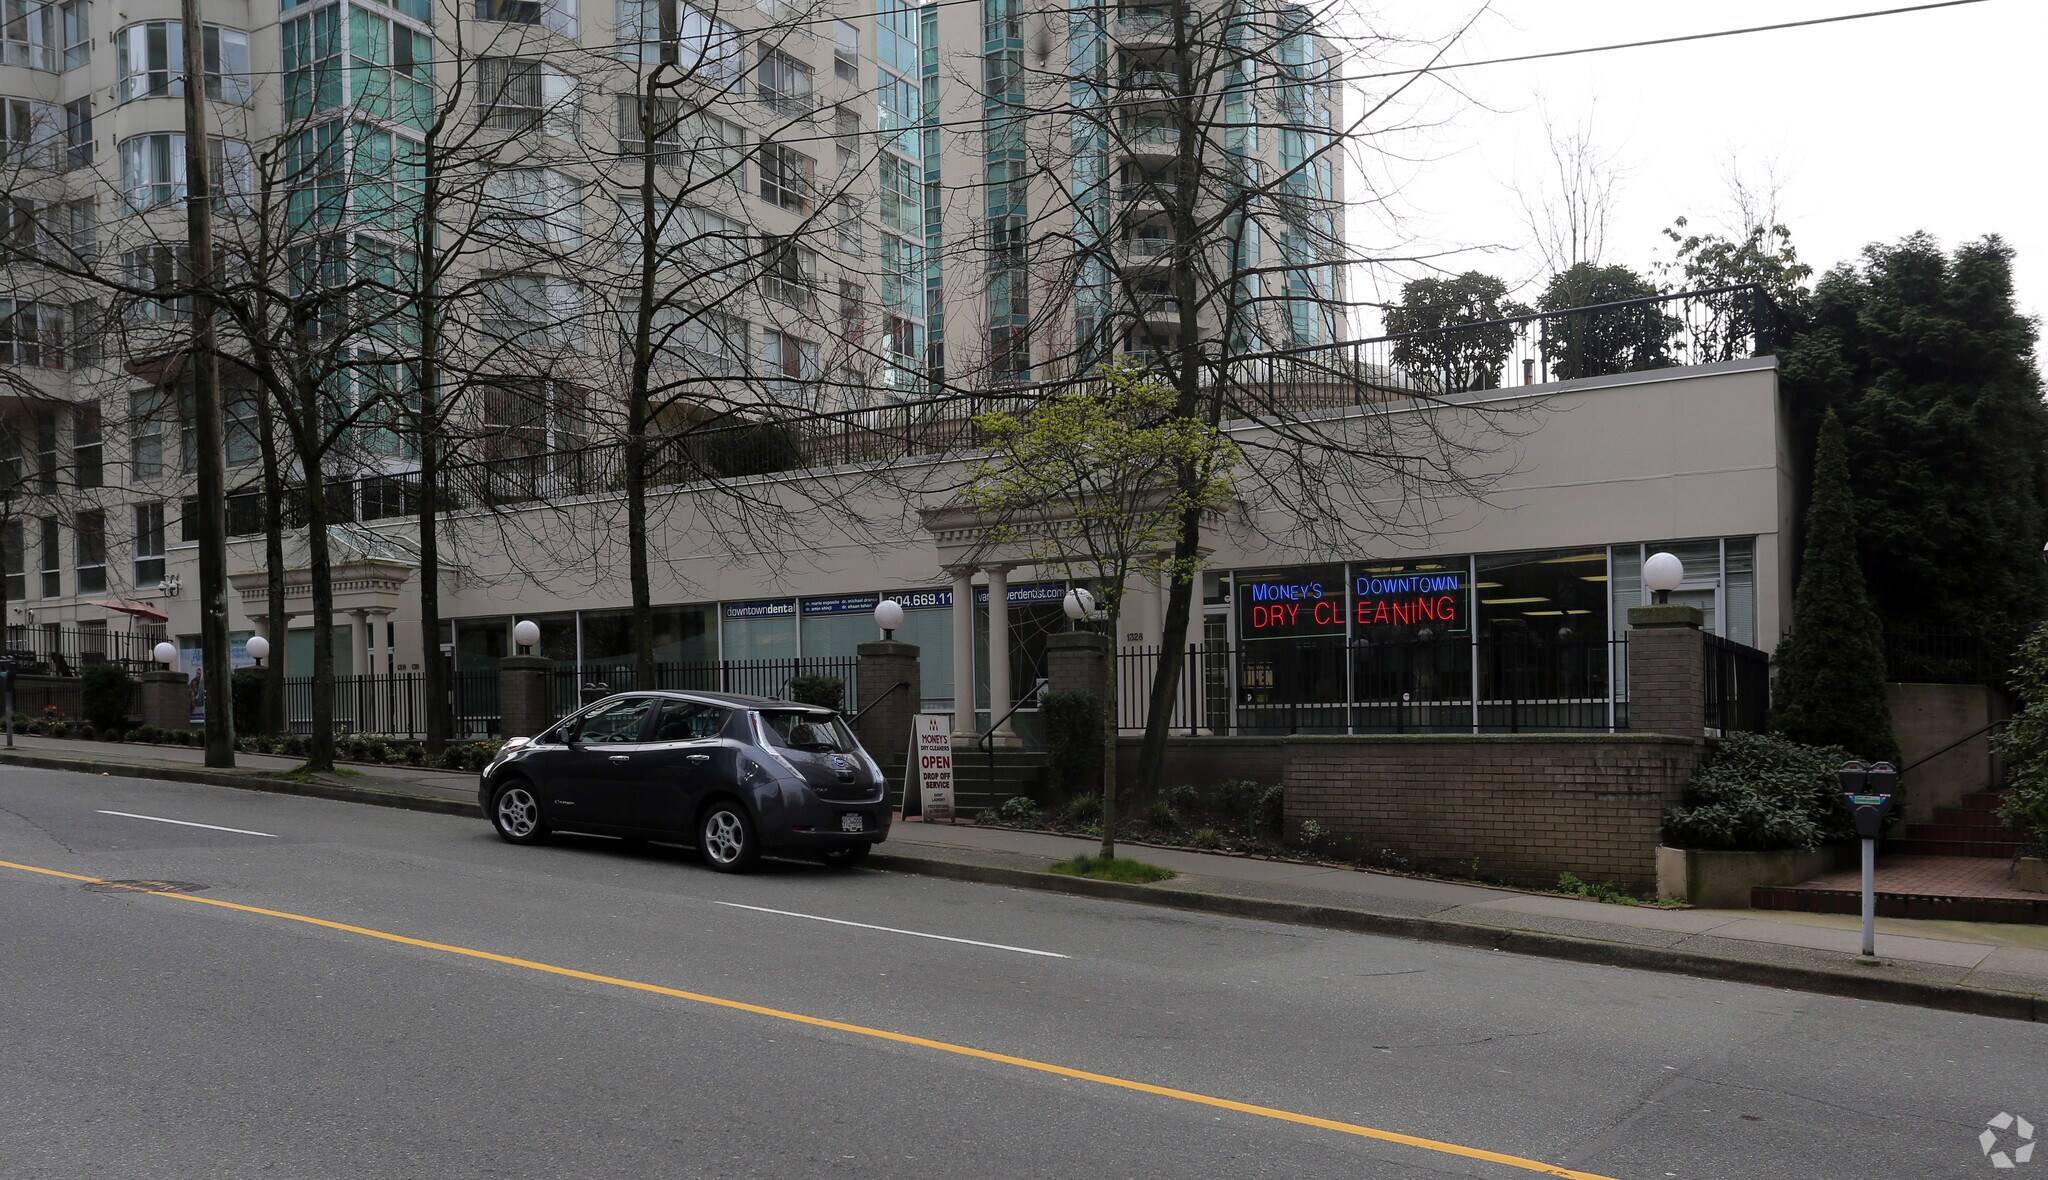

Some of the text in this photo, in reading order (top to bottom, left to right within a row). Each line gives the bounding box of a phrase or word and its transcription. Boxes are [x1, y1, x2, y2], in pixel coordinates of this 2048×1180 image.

[1252, 576, 1458, 601] MONEY'S DOWNTOWN
[888, 592, 953, 606] 04.669.11
[726, 603, 796, 618] downtowndental
[1253, 604, 1300, 628] DRY
[1126, 632, 1144, 642] 1328
[922, 734, 948, 744] MONEY'S
[922, 756, 950, 768] OPEN
